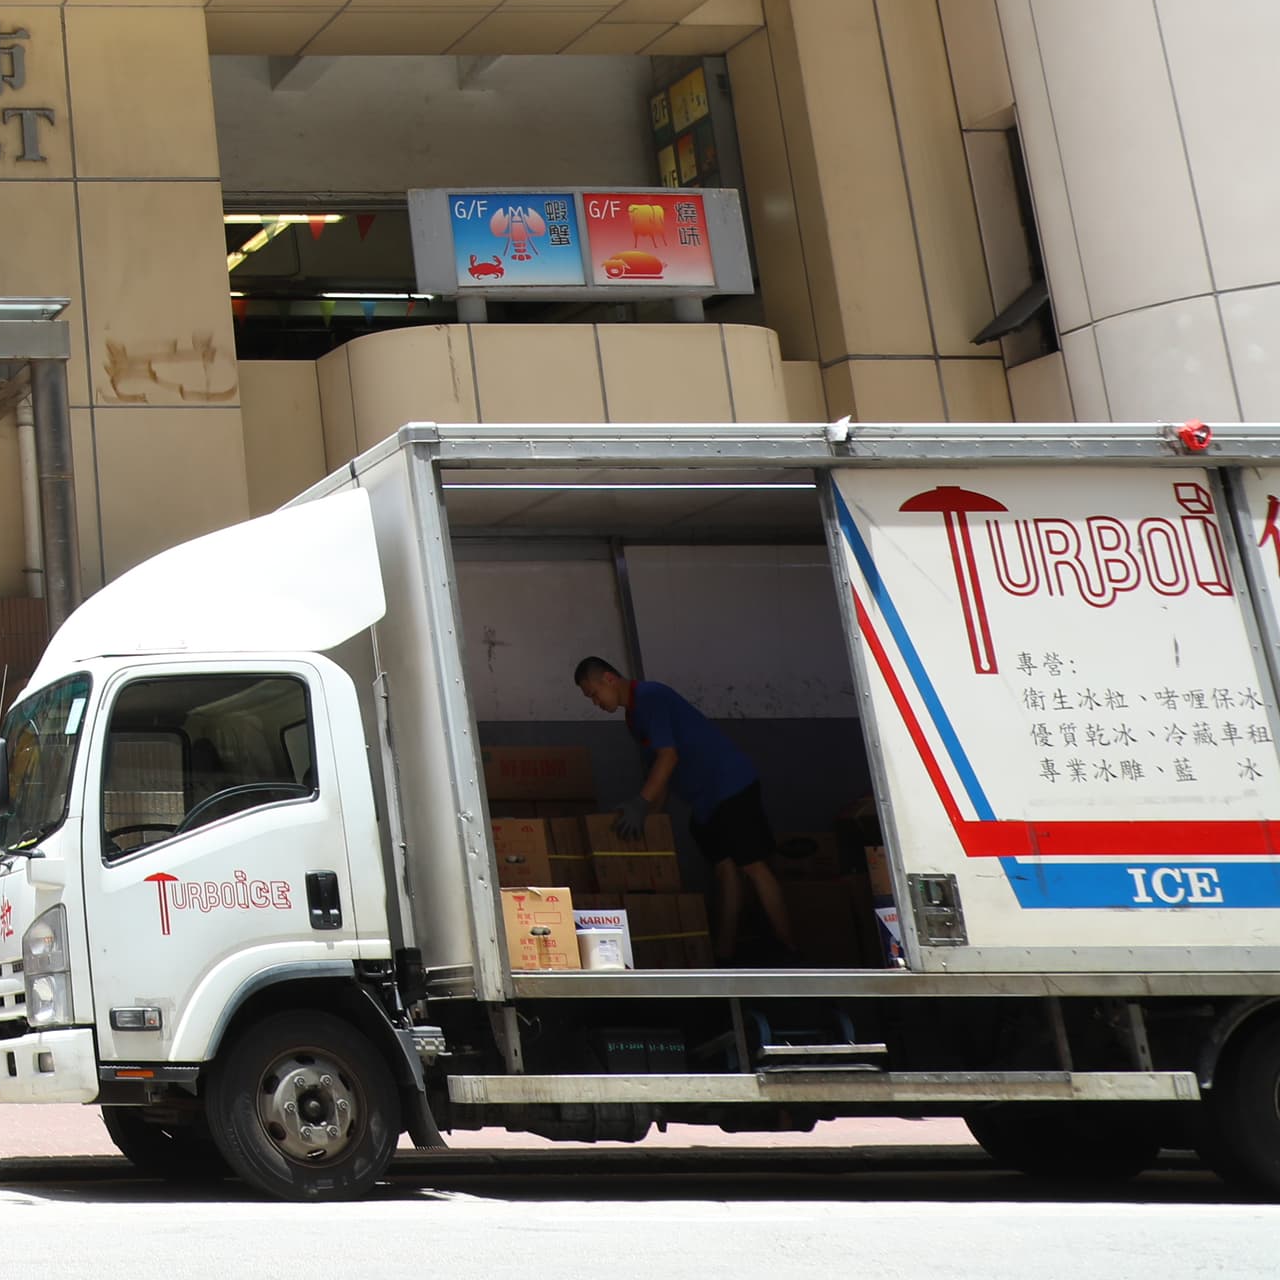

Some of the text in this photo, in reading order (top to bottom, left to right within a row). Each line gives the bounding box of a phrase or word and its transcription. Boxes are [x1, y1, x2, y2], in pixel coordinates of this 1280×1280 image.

[454, 200, 489, 219] G/F
[545, 200, 572, 247] 蝦蟹
[588, 200, 623, 219] G/F
[675, 200, 702, 248] 燒味
[1127, 867, 1224, 904] ICE
